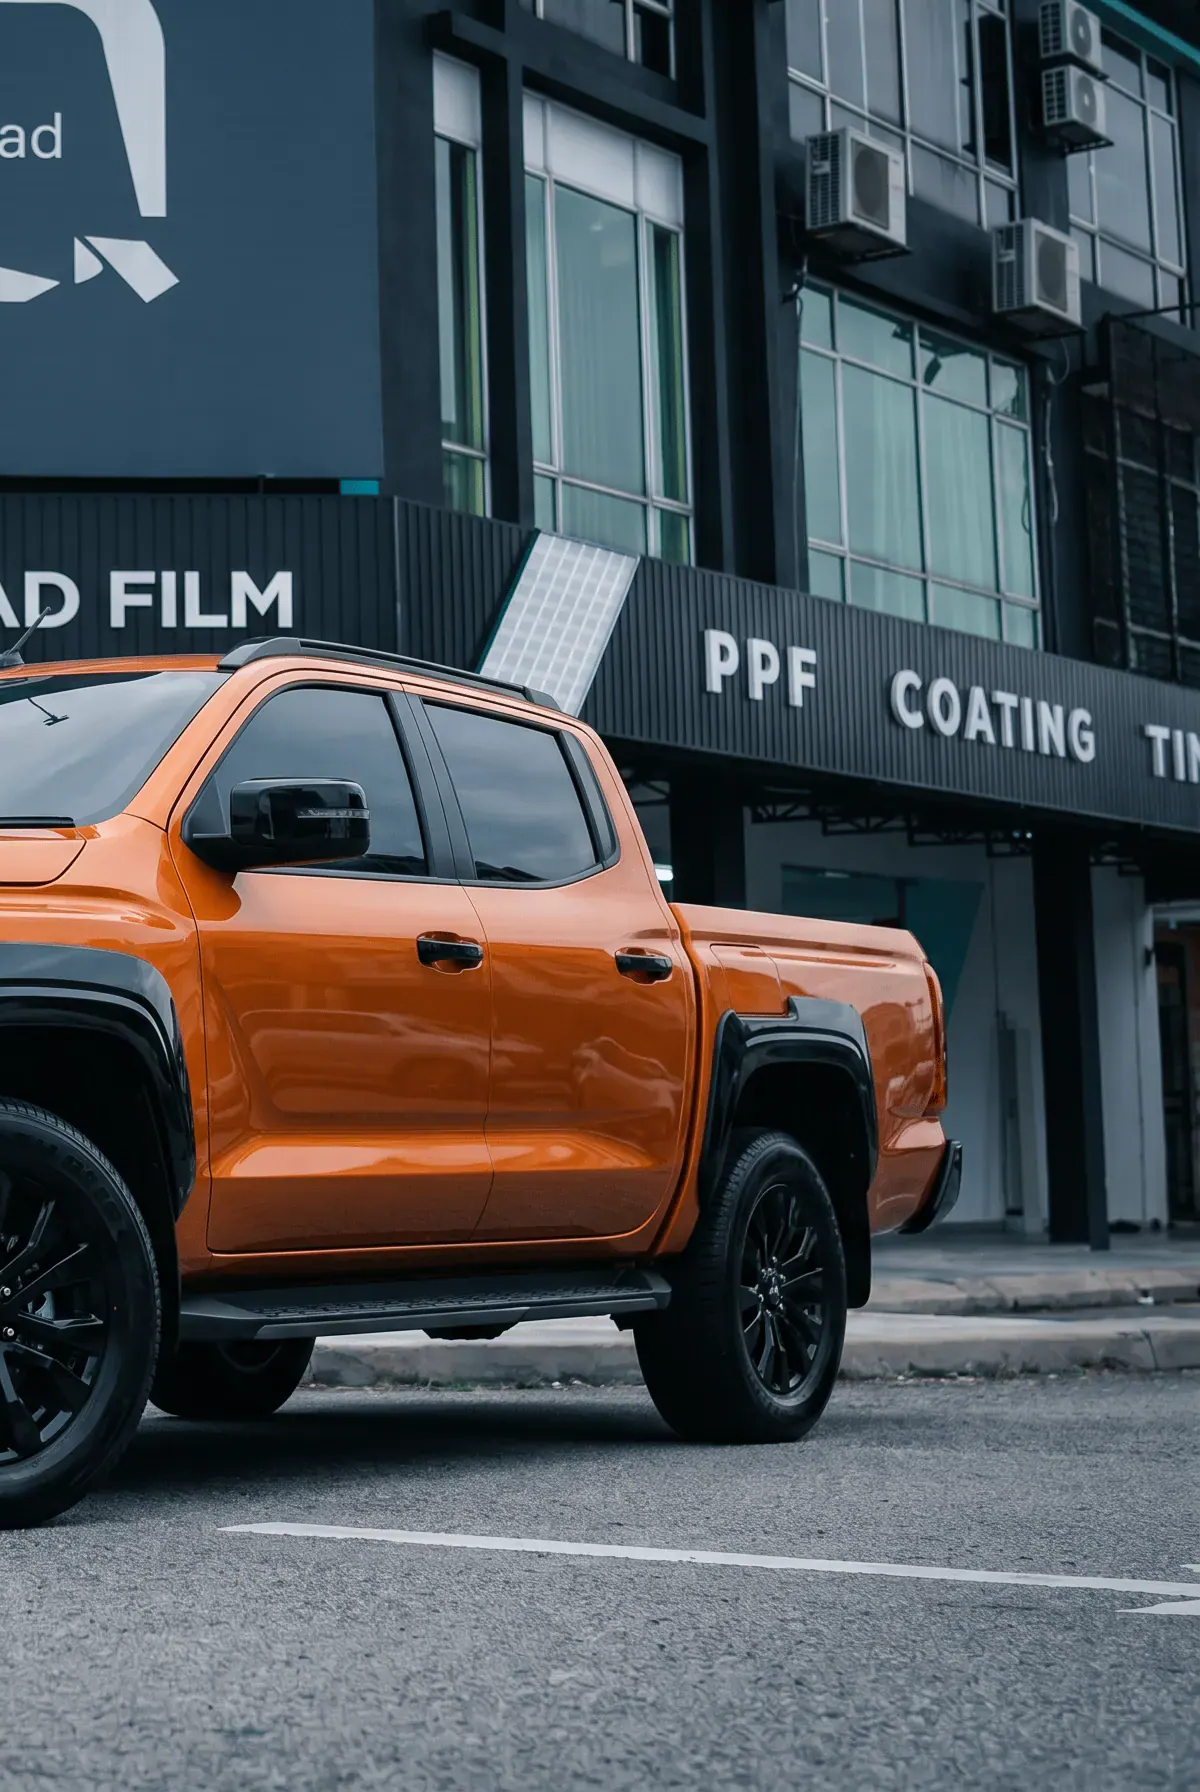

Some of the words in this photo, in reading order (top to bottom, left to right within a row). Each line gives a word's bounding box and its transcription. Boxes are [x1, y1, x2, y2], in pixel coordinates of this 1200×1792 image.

[109, 570, 293, 629] FILM
[704, 628, 820, 708] PPF
[891, 668, 1096, 763] COATING
